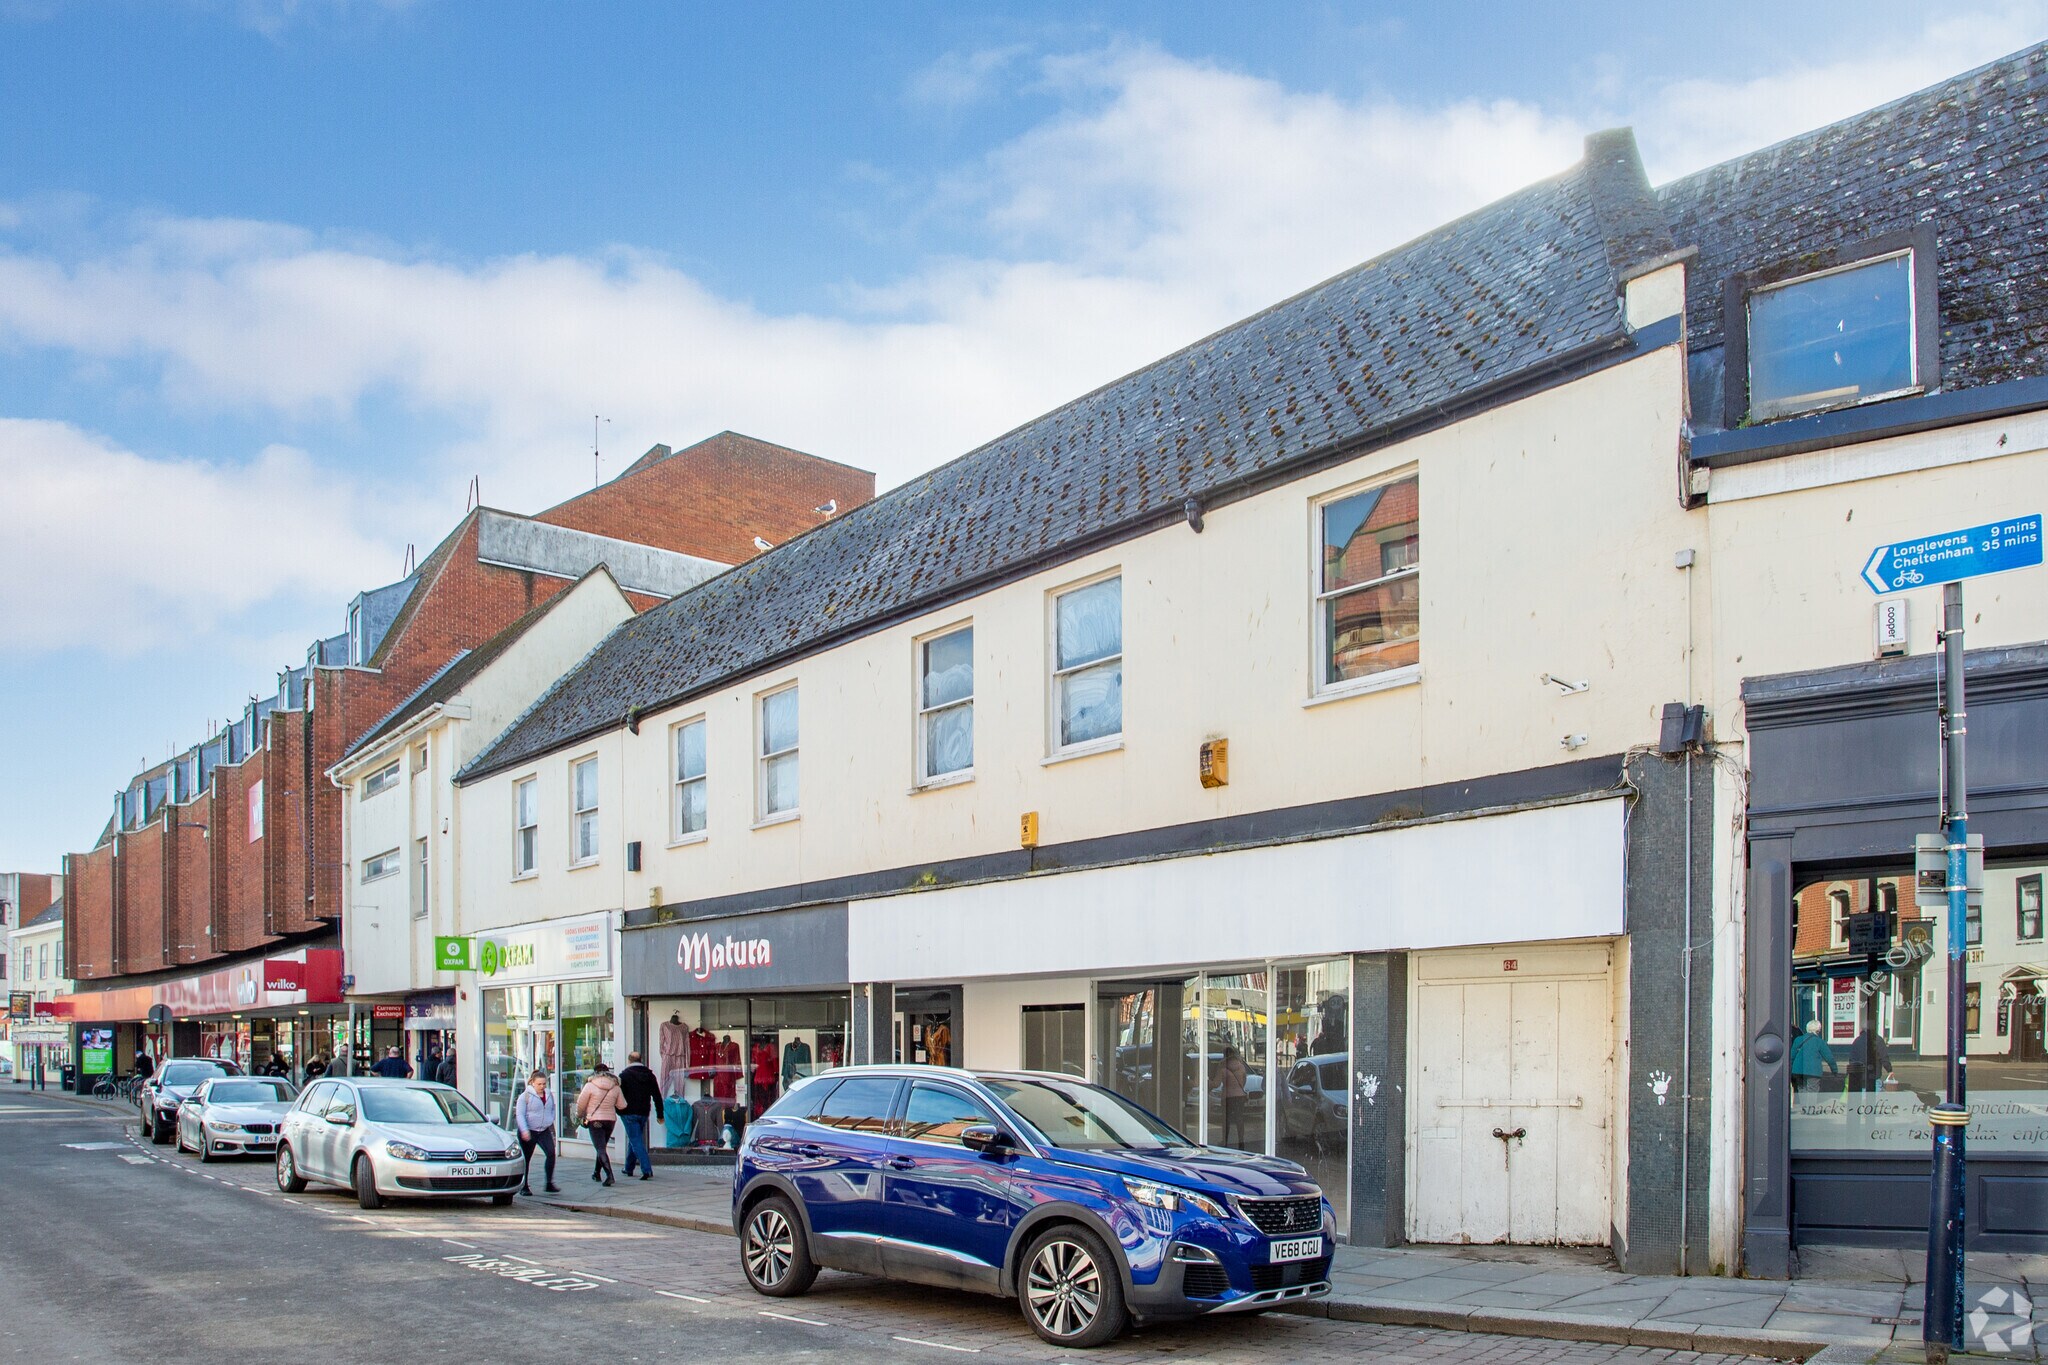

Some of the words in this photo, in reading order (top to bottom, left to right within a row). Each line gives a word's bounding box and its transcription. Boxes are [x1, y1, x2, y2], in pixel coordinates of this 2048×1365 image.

[1893, 535, 1968, 558] Longlevens
[1991, 526, 2000, 537] 9
[2004, 520, 2037, 535] mins
[1893, 545, 1974, 569] Cheltenham
[1981, 539, 2000, 552] 35
[2004, 533, 2038, 548] mins
[1886, 606, 1896, 638] cooper
[500, 943, 534, 968] OXFAM
[677, 931, 771, 982] Matura
[1504, 960, 1518, 970] 64
[1885, 938, 1934, 968] Oli
[266, 978, 297, 990] wilko
[1858, 970, 1887, 997] he
[1801, 1100, 1845, 1115] snacks
[1856, 1099, 1899, 1116] coffee
[1870, 1129, 1894, 1141] eat
[1966, 1123, 1998, 1141] elax
[451, 1167, 474, 1176] PK60
[475, 1167, 492, 1176] JNJ
[1274, 1242, 1300, 1259] VE68
[1301, 1238, 1320, 1256] CGU
